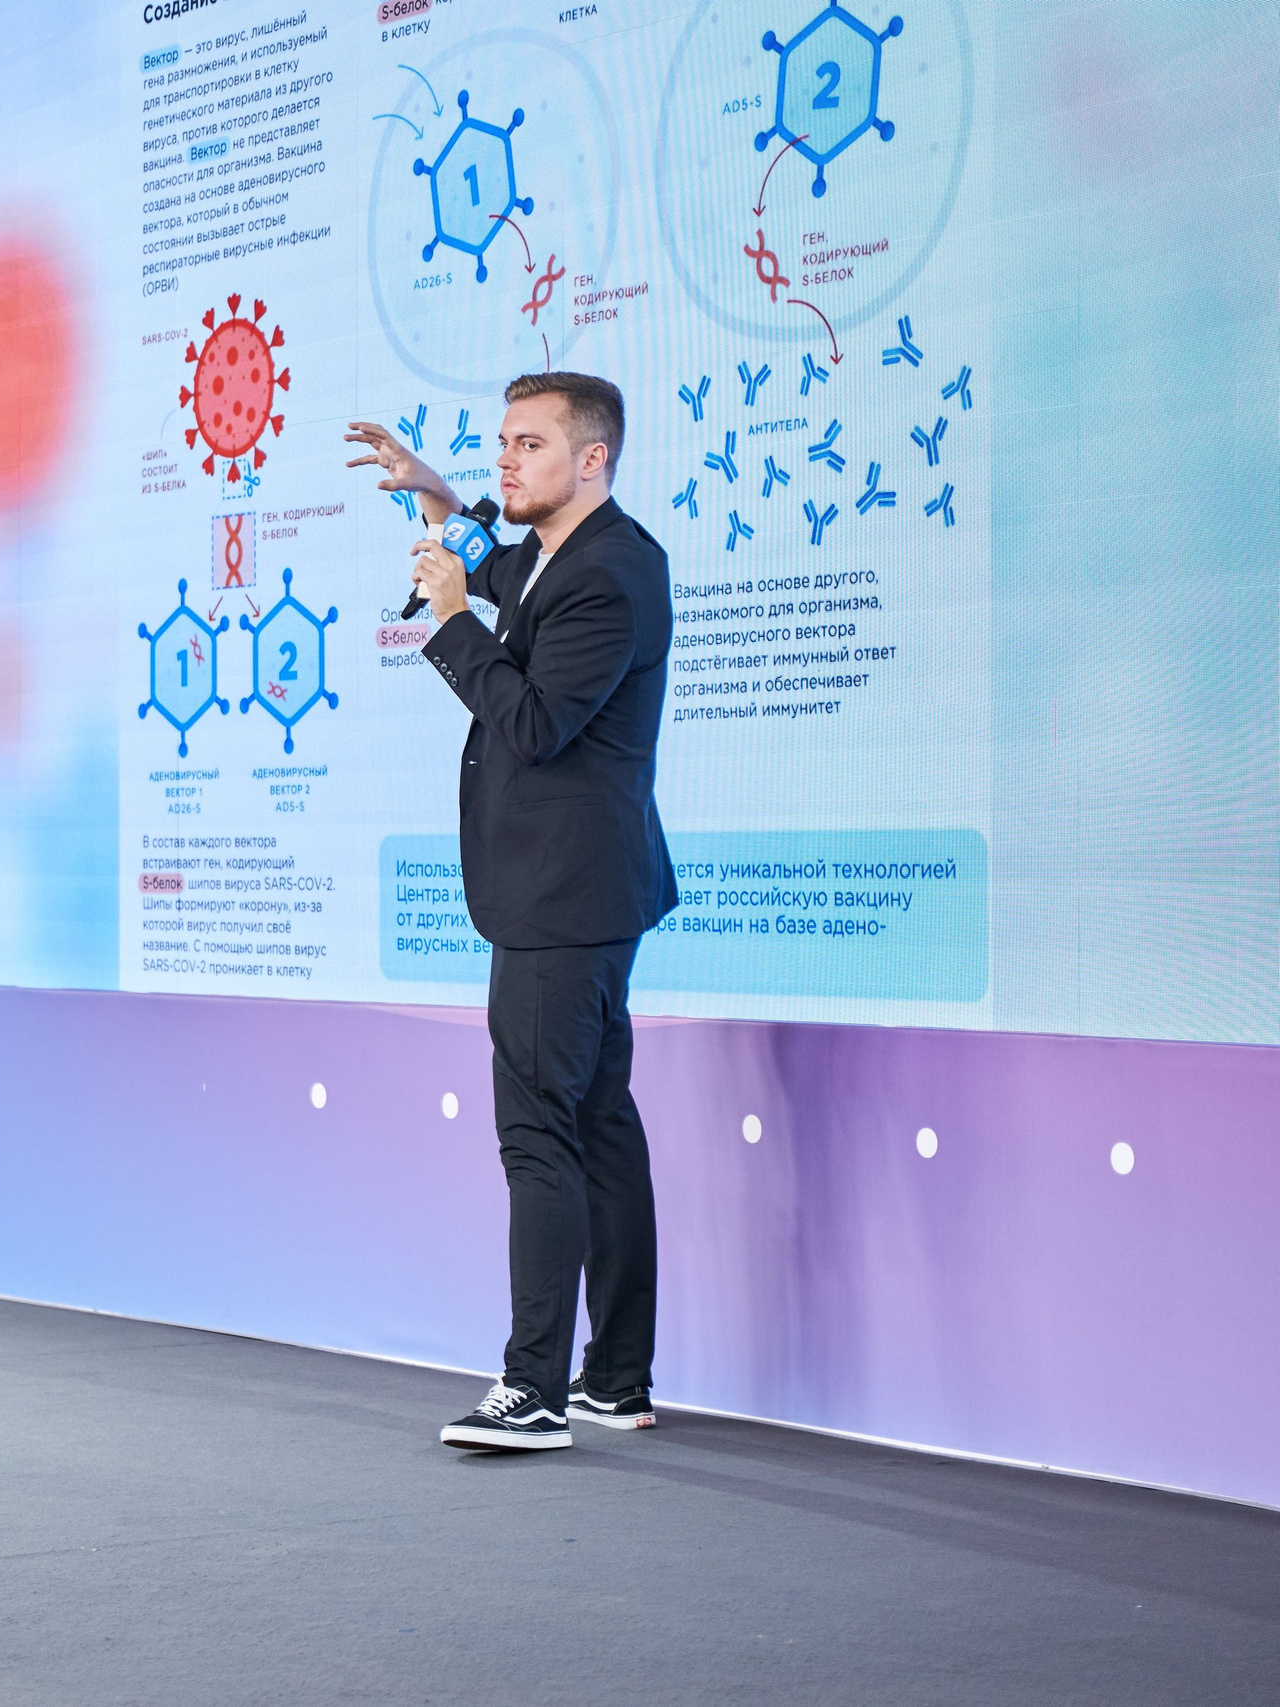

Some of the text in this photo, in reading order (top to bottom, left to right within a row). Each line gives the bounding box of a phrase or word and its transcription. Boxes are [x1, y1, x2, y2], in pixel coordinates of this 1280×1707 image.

[143, 0, 217, 24] Создан
[381, 0, 429, 20] S-белок
[559, 4, 598, 24] КЛЕТКА
[144, 49, 179, 69] Вектор
[196, 40, 213, 54] это
[215, 30, 248, 49] вирус,
[251, 10, 307, 39] лишённый
[382, 19, 431, 42] в клетку
[144, 26, 328, 90] гена размножения, и используемый
[143, 58, 300, 112] для транспортировки в клетку
[812, 61, 841, 110] 2
[143, 71, 334, 131] генетического материала из другого
[722, 95, 762, 115] AD5-S
[143, 96, 320, 154] вируса, против которого делается
[143, 118, 320, 173] вакцина. Вектор не представляет
[143, 139, 323, 193] опасности для организма. Вакцина
[143, 161, 326, 214] создана на основе аденовирусного
[463, 163, 481, 207] 1
[143, 191, 289, 235] вектора, который в обычном
[143, 213, 286, 255] состоянии вызывает острые
[142, 225, 331, 277] респираторные вирусные инфекции
[802, 237, 890, 266] КОДИРУЮЩИЙ
[142, 276, 179, 297] (ОРВИ)
[413, 273, 453, 291] AD26-S
[802, 267, 855, 287] S-БЕЛОК
[574, 281, 649, 307] КОДИРУЮЩИЙ
[574, 307, 619, 326] S-БЕЛОК
[142, 328, 188, 345] SARS-COV-2
[748, 417, 809, 436] АНТИТЕЛА
[142, 449, 167, 461] «ШИП»
[142, 463, 178, 478] СОСТОИТ
[442, 468, 492, 483] АНТИТЕЛА
[142, 479, 187, 494] ИЗ S-БЕЛКА
[283, 502, 345, 521] КОДИРУЮЩИЙ
[262, 526, 299, 541] S-БЕЛОК
[674, 569, 879, 600] Вакцина на основе другого,
[674, 595, 883, 624] незнакомого для организма,
[381, 630, 428, 645] S-белок
[674, 622, 856, 649] аденовирусного вектора
[176, 648, 188, 687] 1
[279, 640, 298, 681] 2
[381, 652, 429, 668] вырабо
[674, 646, 897, 673] подстёгивает иммунный ответ
[674, 673, 869, 699] организма и обеспечивает
[673, 699, 841, 723] длительный иммунитет
[149, 769, 219, 782] АДЕНОВИРУСНЫЙ
[252, 765, 328, 779] АДЕНОВИРУСНЫЙ
[165, 787, 203, 798] ВЕКТОР 1
[270, 784, 311, 796] ВЕКТОР 2
[168, 803, 201, 814] AD26-S
[276, 802, 305, 812] AD5-S
[143, 835, 277, 851] В состав каждого вектора
[143, 856, 295, 871] встраивают ген, кодирующий
[673, 858, 957, 882] ется уникальной технологией
[143, 876, 336, 892] S-белок шипов вируса SARS-COV-2.
[396, 883, 450, 905] Центра
[143, 896, 322, 914] Шипы формируют «корону», из-за
[717, 886, 827, 909] российскую
[834, 890, 913, 912] вакцину
[143, 918, 292, 935] которой вирус получил своё
[396, 912, 468, 931] от других
[656, 914, 886, 938] ре вакцин на базе адено-
[143, 939, 327, 959] название. С помощью шипов вирус
[396, 937, 469, 956] вирусных
[143, 958, 312, 980] SARS-COV-2 проникает в клетку
